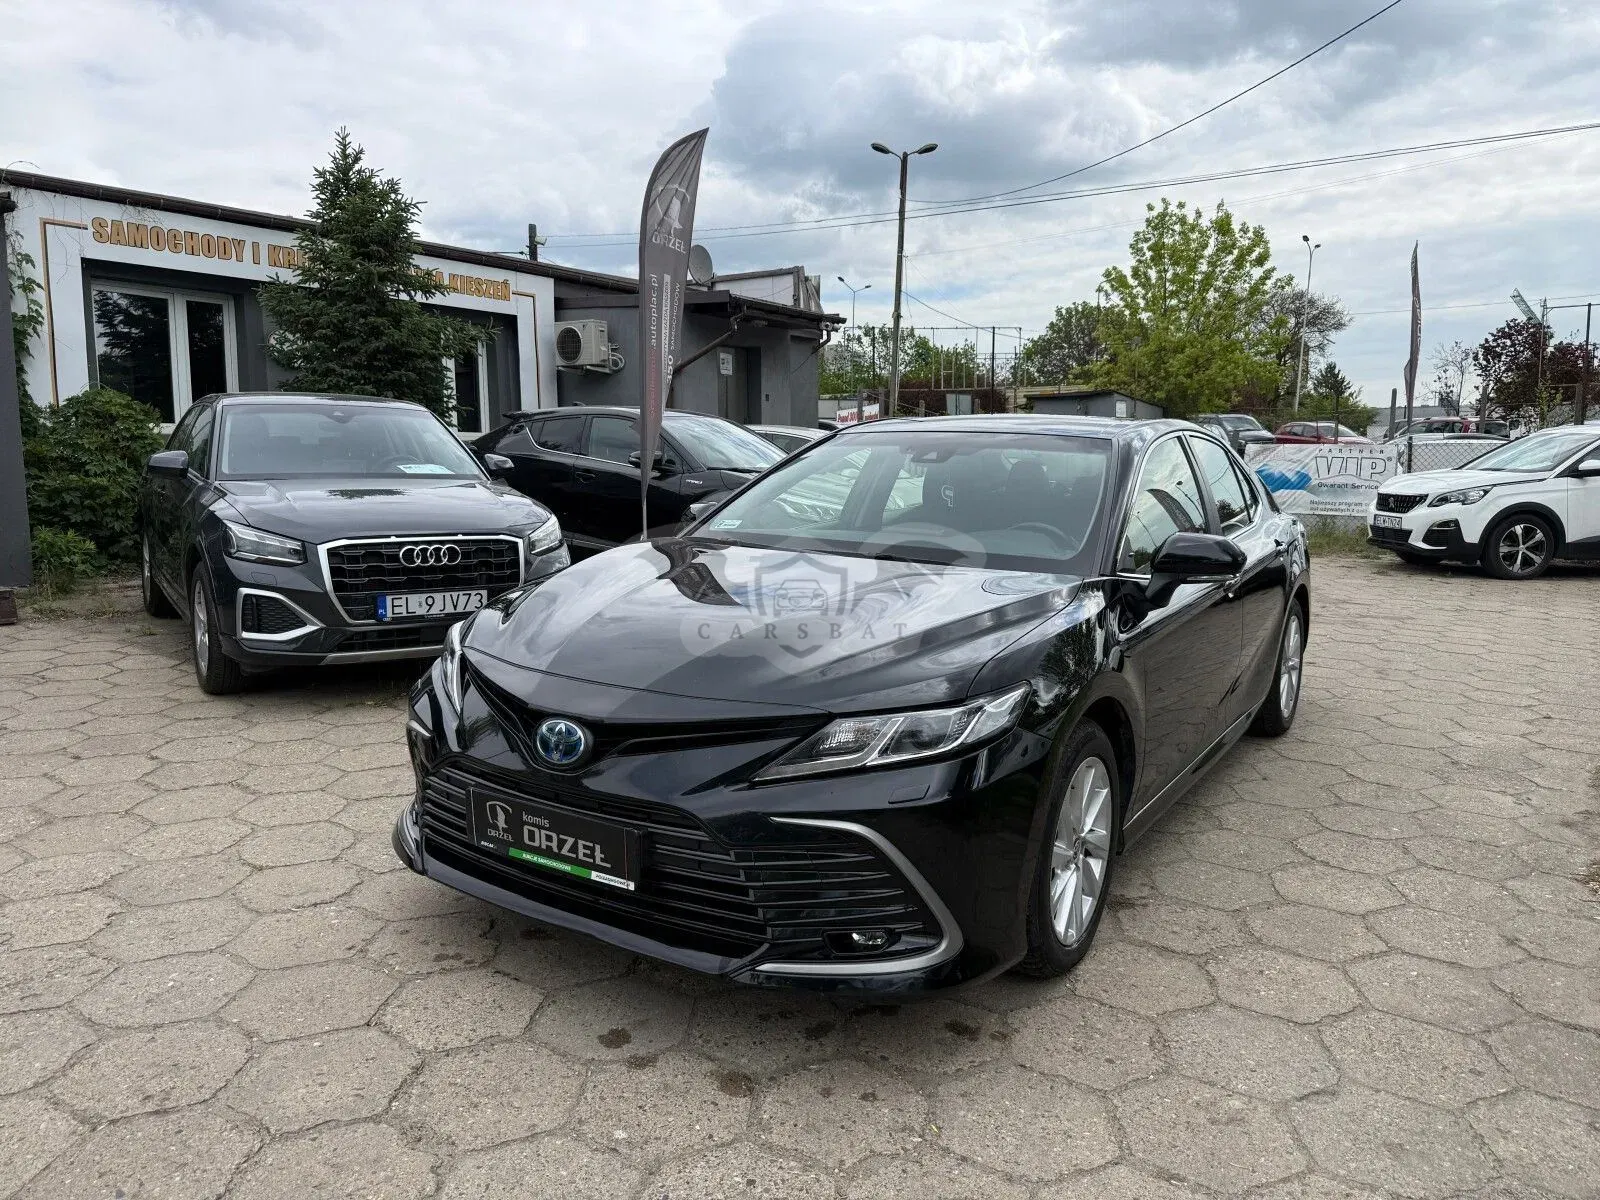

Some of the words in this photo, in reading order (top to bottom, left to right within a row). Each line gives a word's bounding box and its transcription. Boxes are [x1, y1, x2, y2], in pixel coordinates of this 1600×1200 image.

[652, 231, 687, 254] ORZEŁ
[92, 216, 246, 262] SAMOCHODY
[252, 241, 260, 265] I
[449, 272, 511, 302] KIESZEŃ
[1315, 456, 1387, 479] VIP
[1317, 481, 1348, 489] Gwarant
[1351, 482, 1379, 490] Service
[391, 596, 417, 615] EL
[424, 592, 484, 613] 9JV73
[522, 810, 550, 828] komis
[523, 825, 612, 868] ORZEŁ
